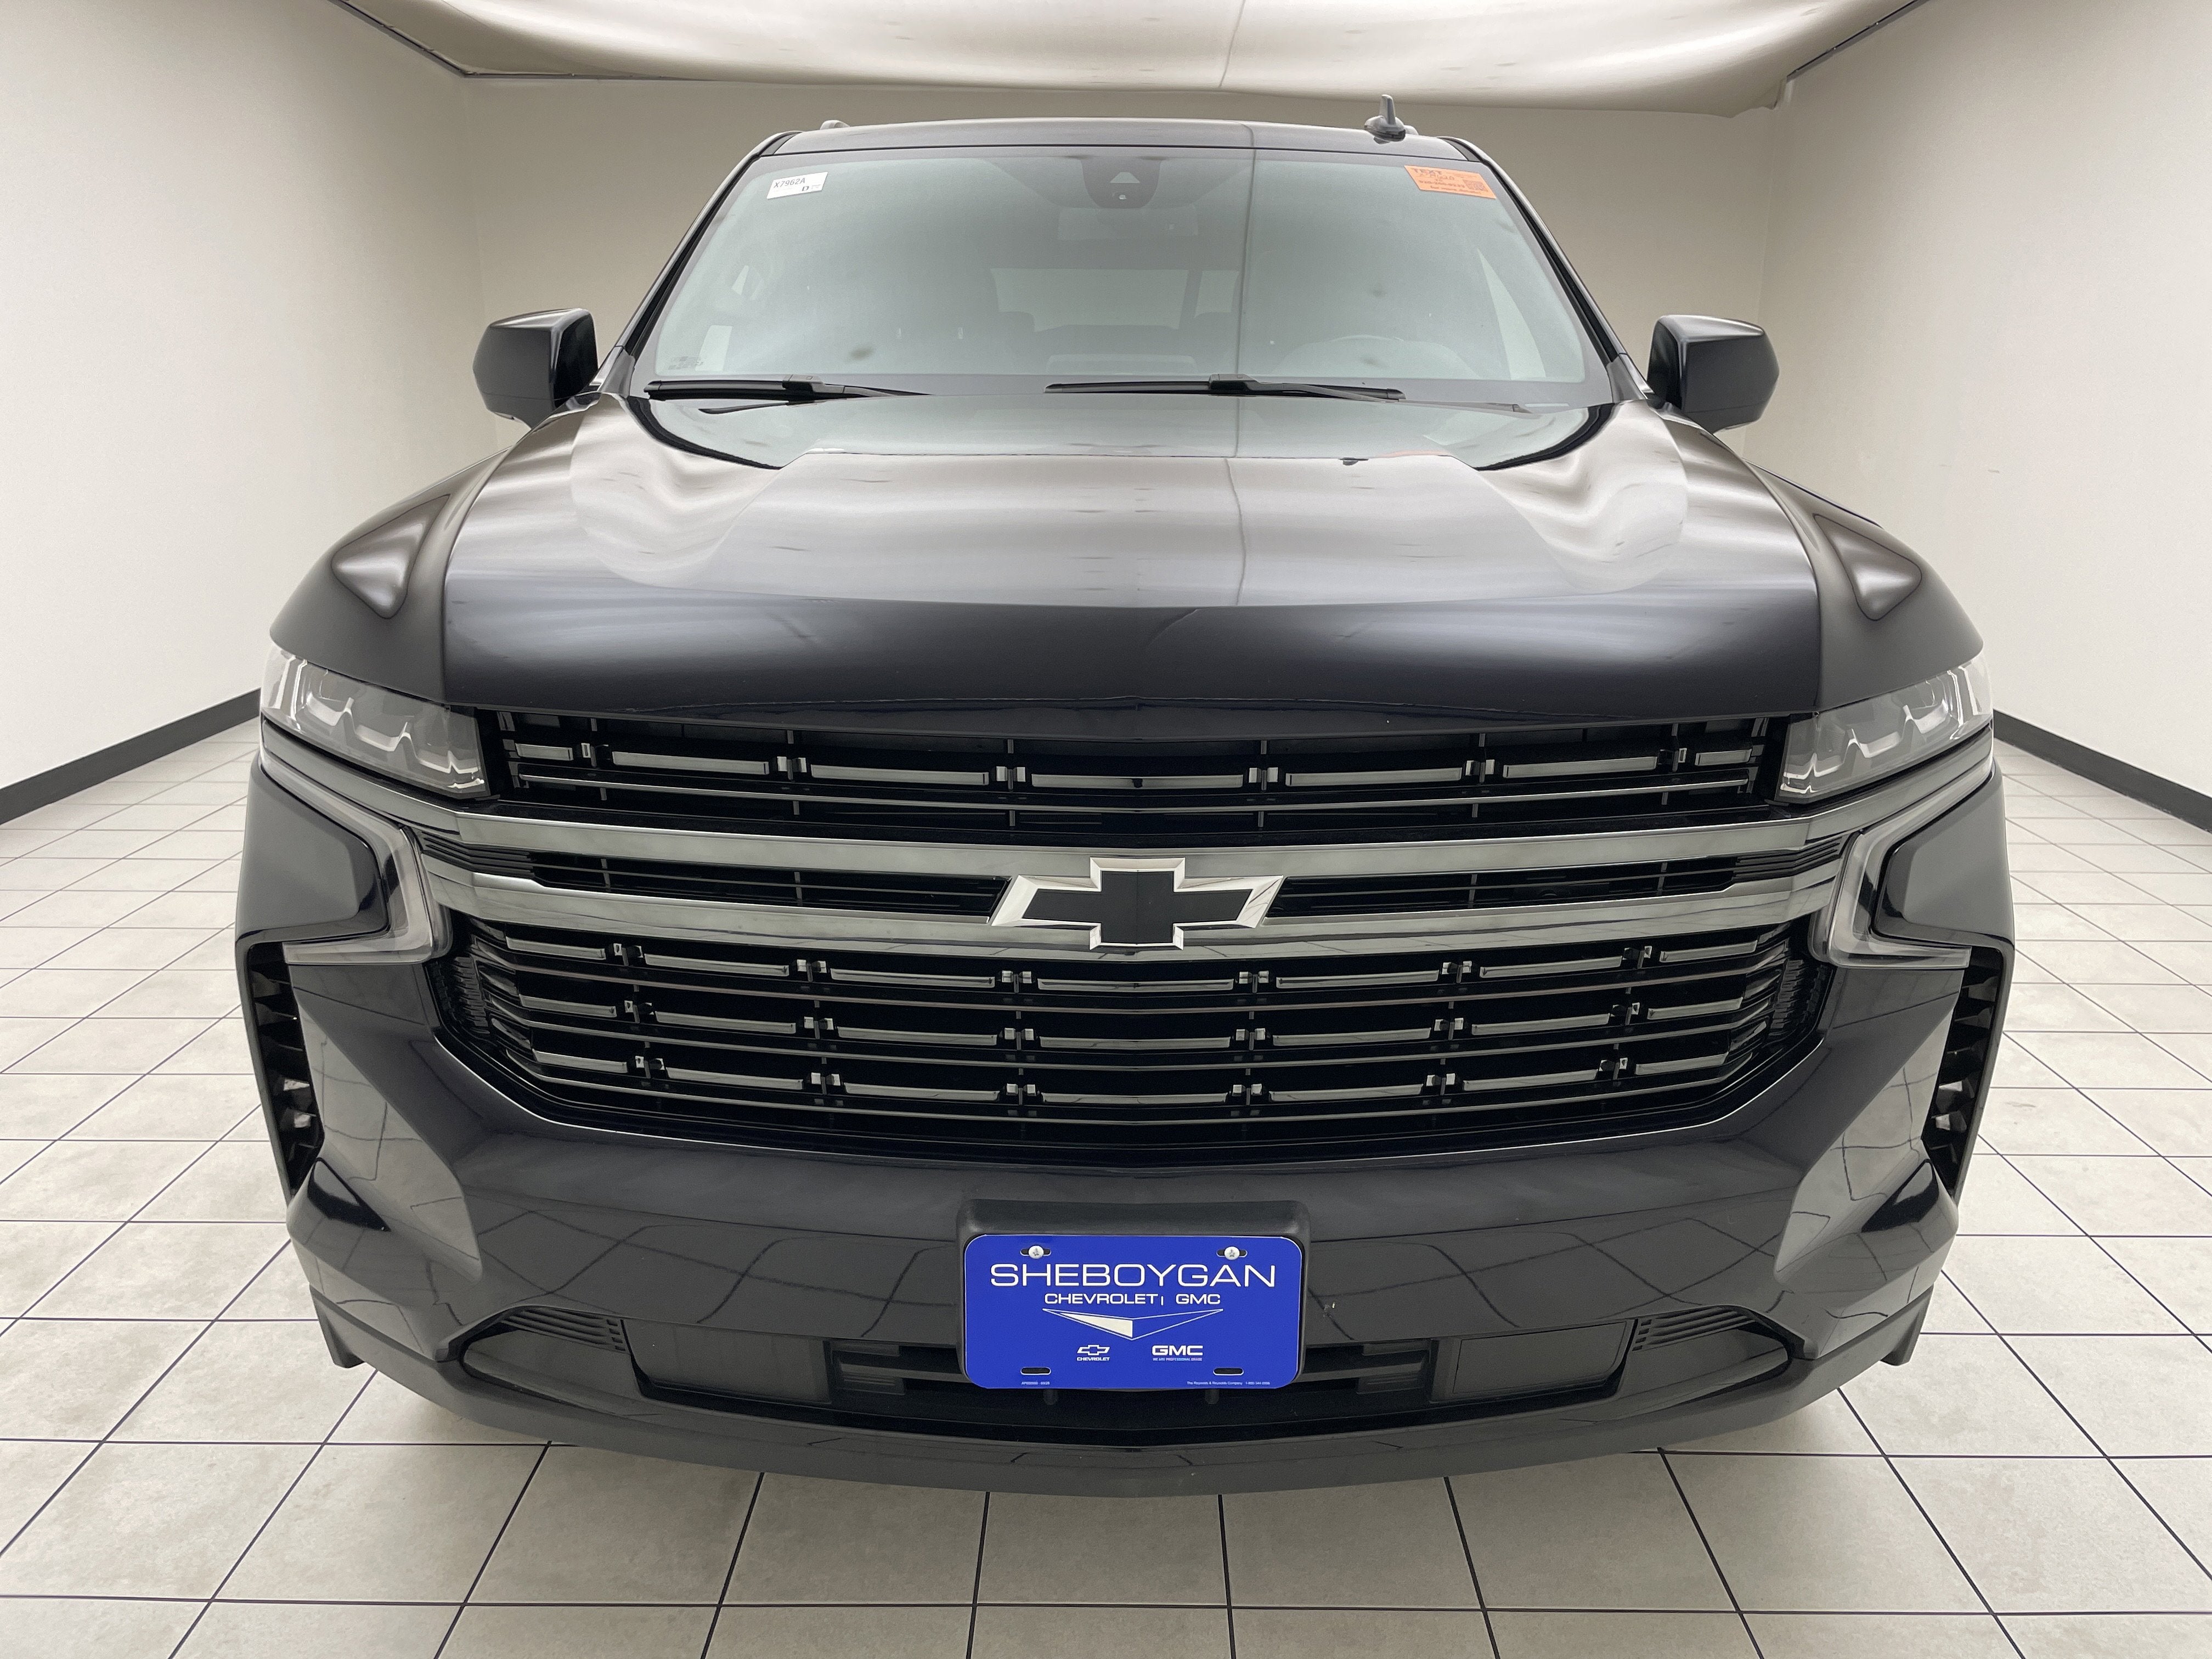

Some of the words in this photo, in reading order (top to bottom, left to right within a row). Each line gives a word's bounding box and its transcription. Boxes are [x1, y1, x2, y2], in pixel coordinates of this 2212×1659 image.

[774, 177, 805, 189] X7962A
[990, 1263, 1276, 1288] SHEBOYGAN
[1044, 1293, 1159, 1305] CHEVROLET
[1175, 1293, 1221, 1305] GMC
[1152, 1345, 1203, 1356] GMC
